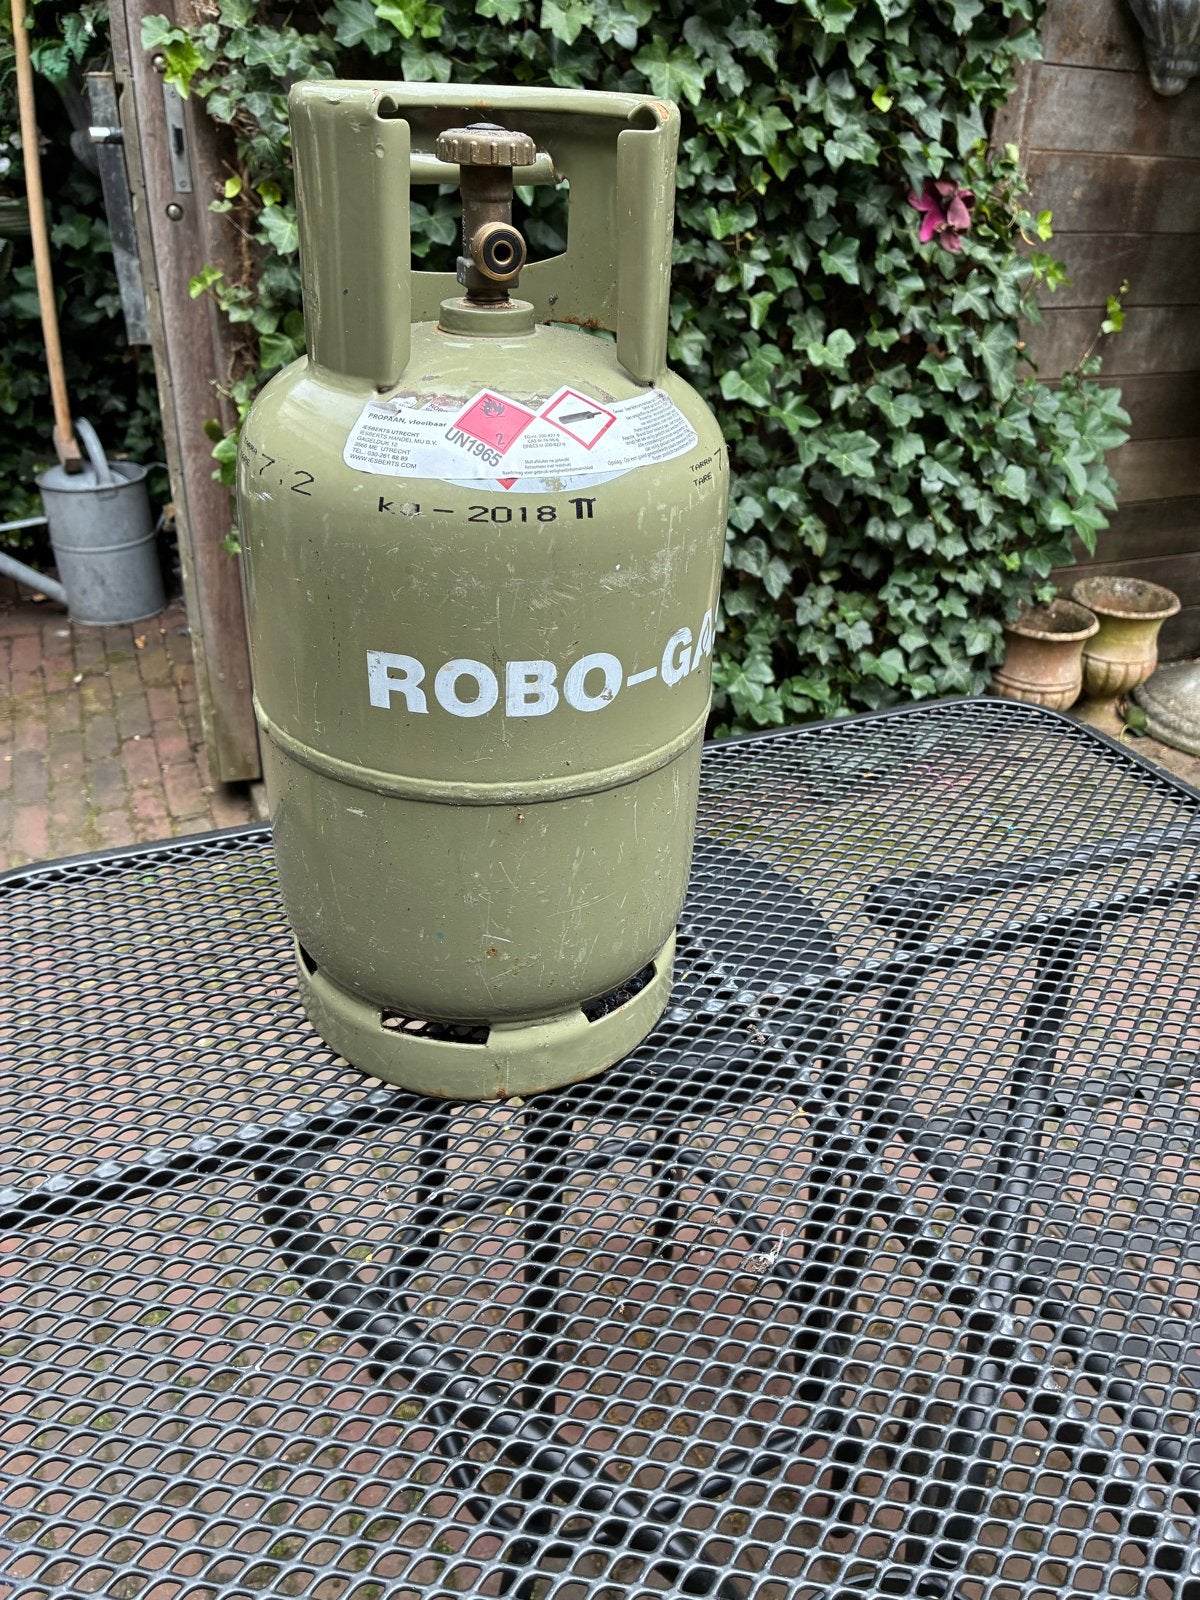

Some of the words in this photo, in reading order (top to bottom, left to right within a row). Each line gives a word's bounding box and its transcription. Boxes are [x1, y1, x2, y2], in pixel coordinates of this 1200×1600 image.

[368, 413, 407, 424] PROPAAN,
[409, 420, 447, 428] vloeibaar
[388, 436, 413, 444] HANDEL
[391, 430, 420, 438] UTRECHT
[496, 433, 505, 446] 2
[380, 446, 411, 455] UTRECHT
[444, 427, 503, 468] UN1965
[367, 451, 390, 459] 030-261
[689, 457, 713, 472] TARRA
[693, 472, 713, 486] TARE
[467, 505, 558, 523] 2018
[366, 594, 720, 718] ROBO-GA
